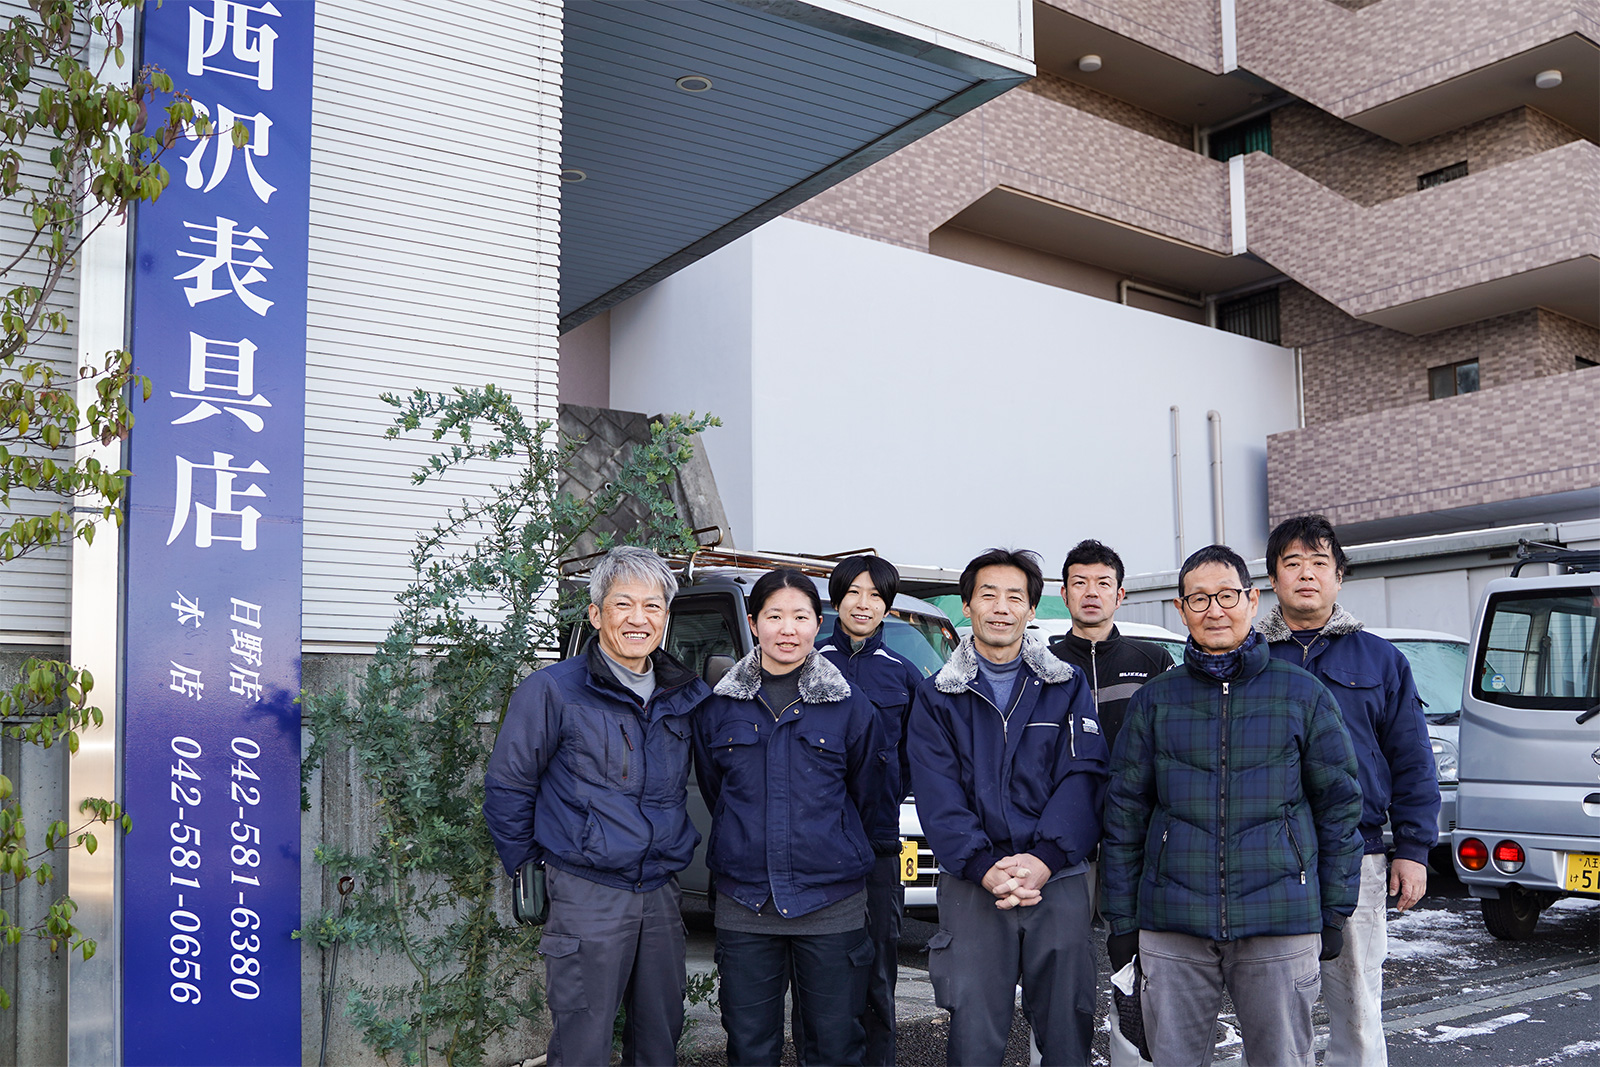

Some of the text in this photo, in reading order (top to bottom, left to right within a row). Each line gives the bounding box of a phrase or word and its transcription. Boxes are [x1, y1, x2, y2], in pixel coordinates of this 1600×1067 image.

[166, 0, 282, 551] 西沢表具店
[169, 590, 205, 1005] 本店 042-581-0656
[230, 597, 263, 1000] 日野店 042-581-6380
[1583, 857, 1600, 868] 八王
